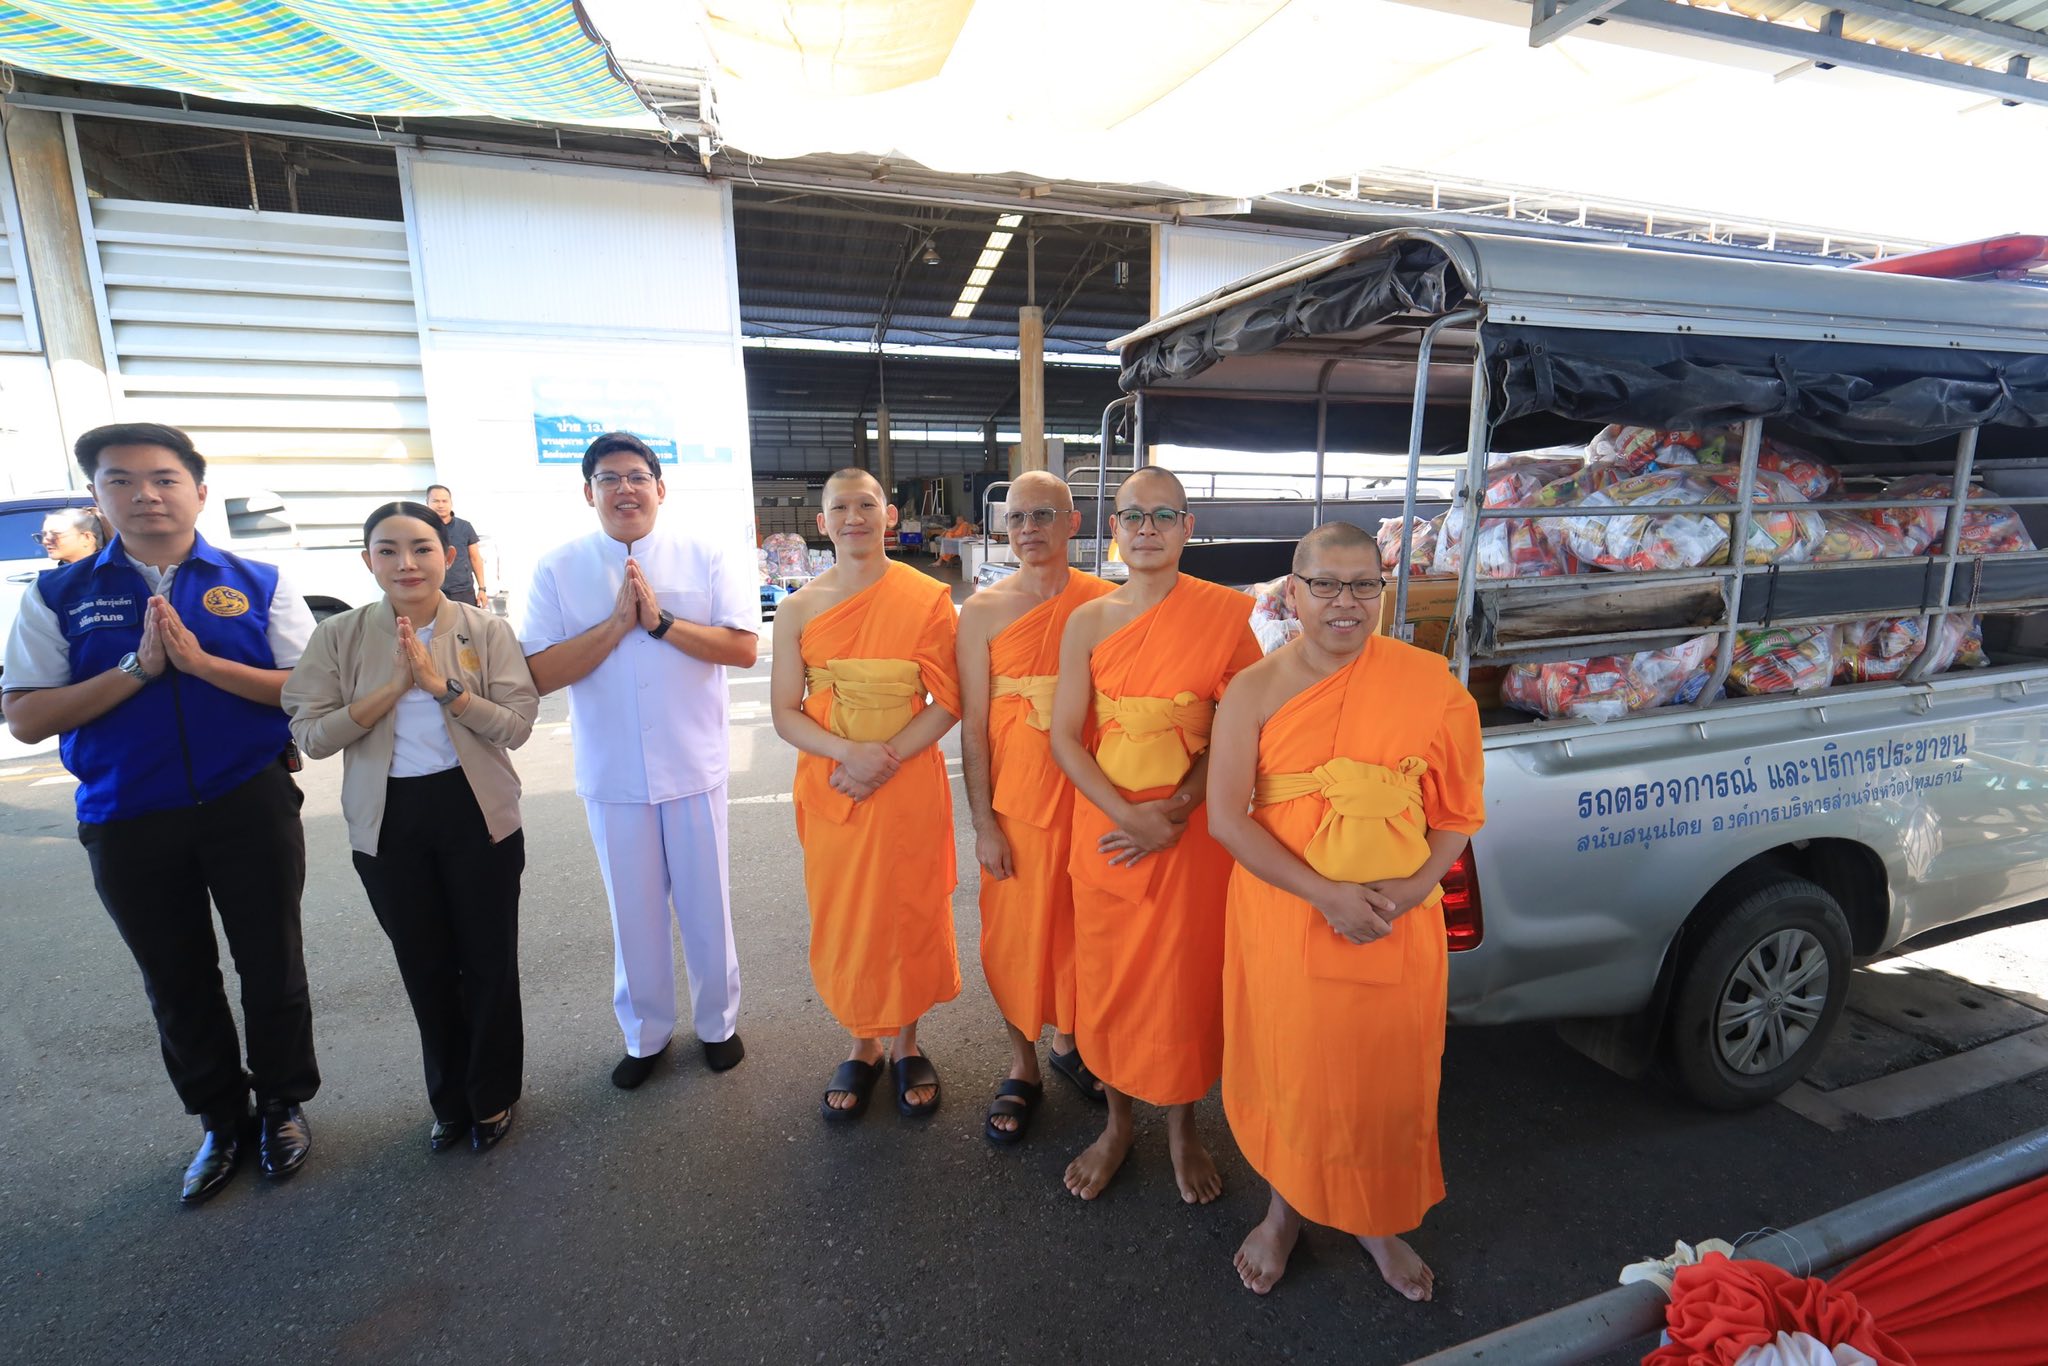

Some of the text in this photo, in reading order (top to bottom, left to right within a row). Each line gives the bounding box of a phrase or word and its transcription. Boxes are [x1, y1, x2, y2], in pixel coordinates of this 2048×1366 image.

[79, 612, 124, 628] ปลัดอำเภอ
[1576, 763, 1965, 853] สนับสนุนโดย องค์การบริหารส่วนจังหวัดปทุมธานี
[1578, 733, 1967, 819] รถตรวจการณ์ และบริการประชาชน
